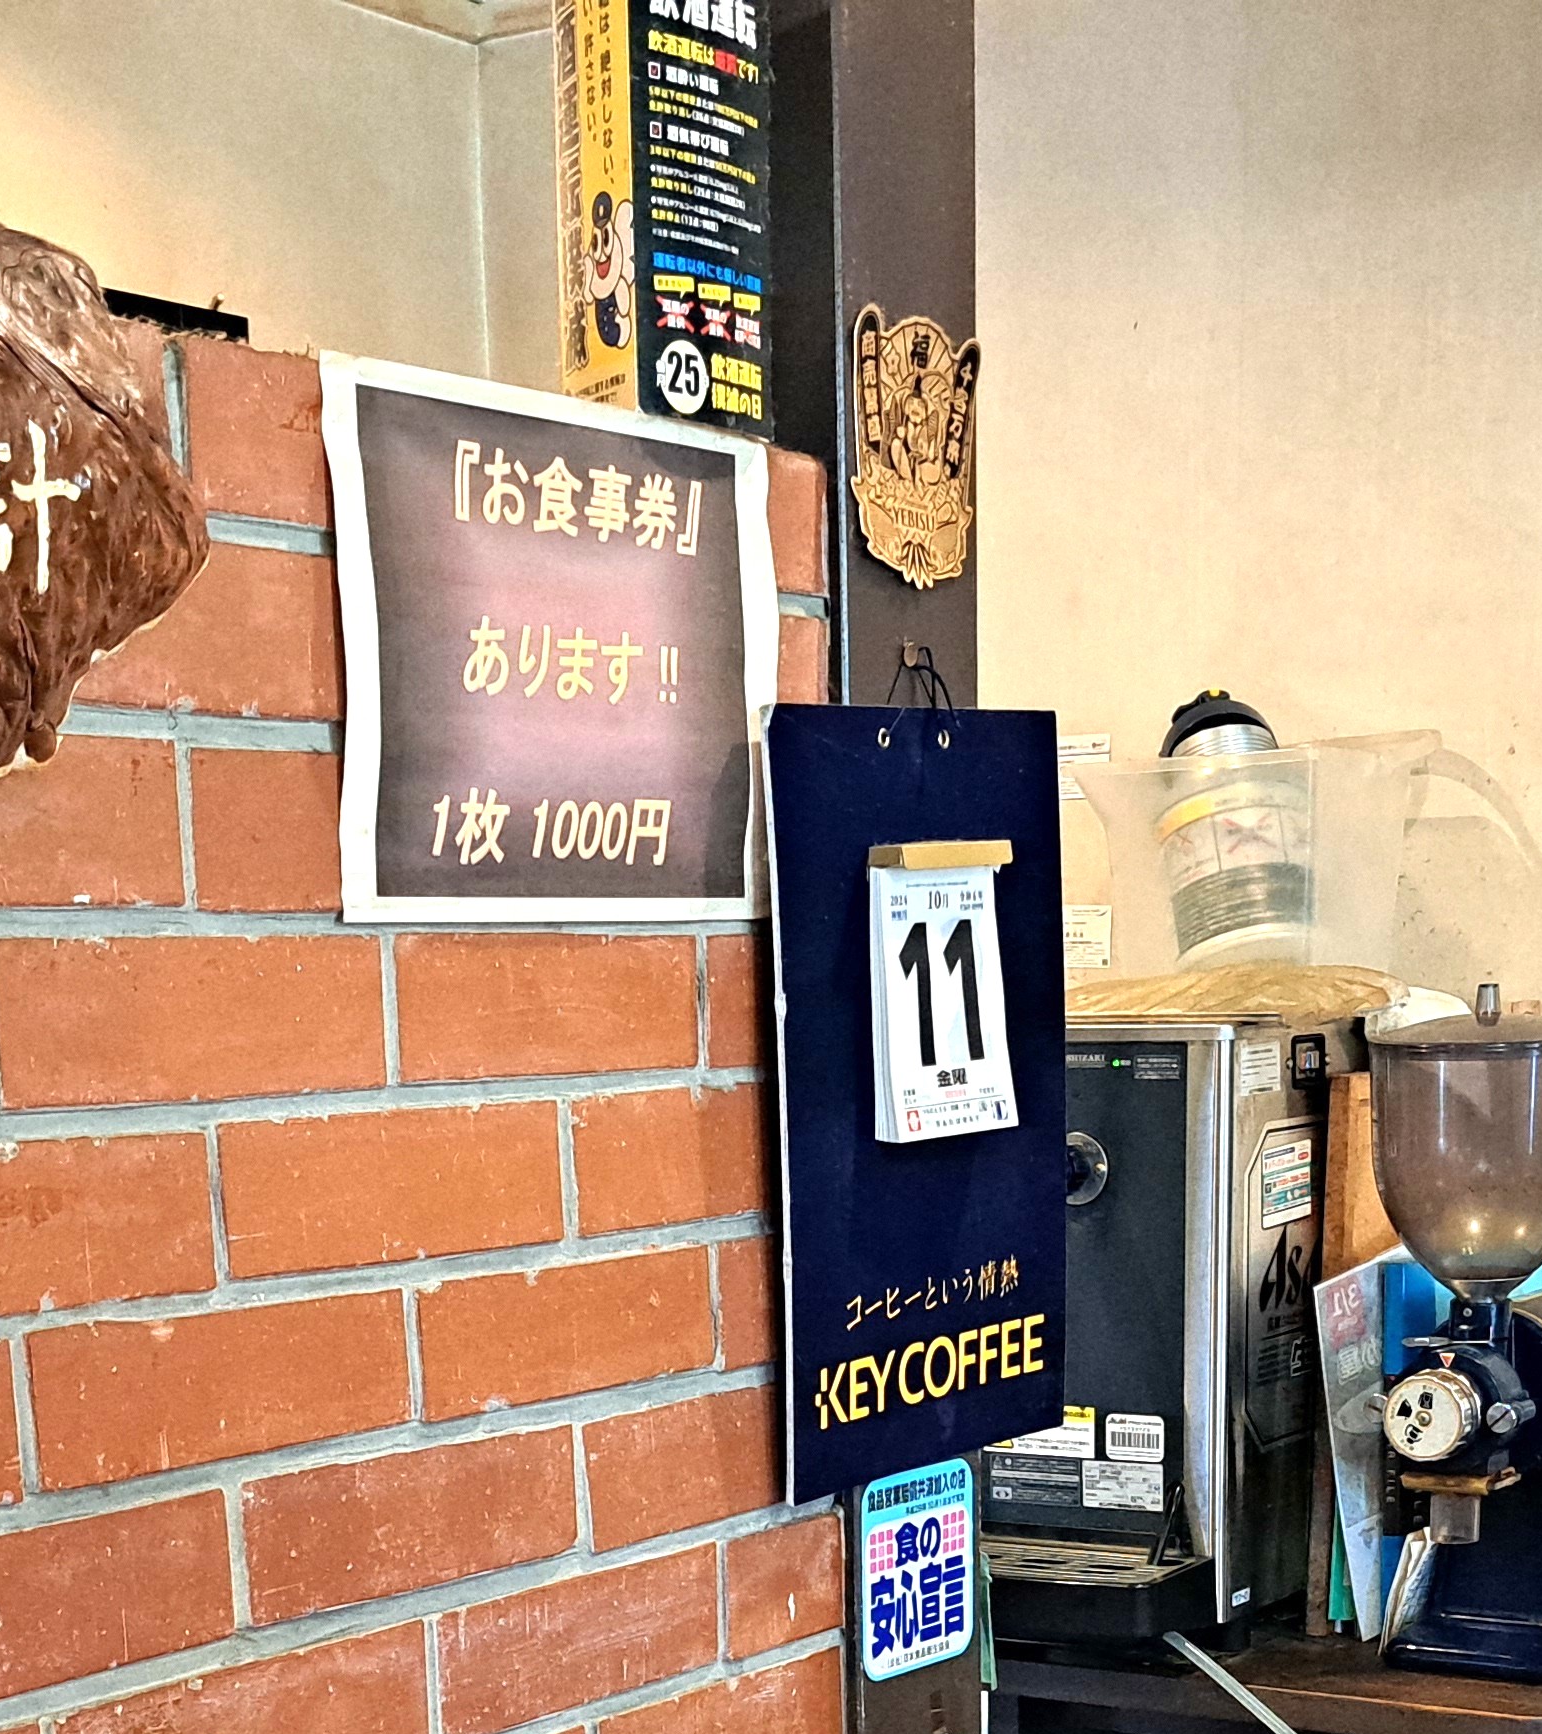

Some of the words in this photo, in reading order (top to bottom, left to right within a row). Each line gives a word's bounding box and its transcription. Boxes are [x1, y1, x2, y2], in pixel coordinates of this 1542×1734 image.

[667, 350, 701, 397] 25
[454, 438, 703, 557] 『お食事券』
[892, 505, 937, 534] YEBISU
[431, 787, 511, 865] 1枚
[532, 798, 673, 866] 1000円
[897, 917, 986, 1068] 11
[845, 1253, 1019, 1332] コーヒーという情熱
[894, 1516, 942, 1568] 食の
[870, 1554, 966, 1661] 安心宣言
